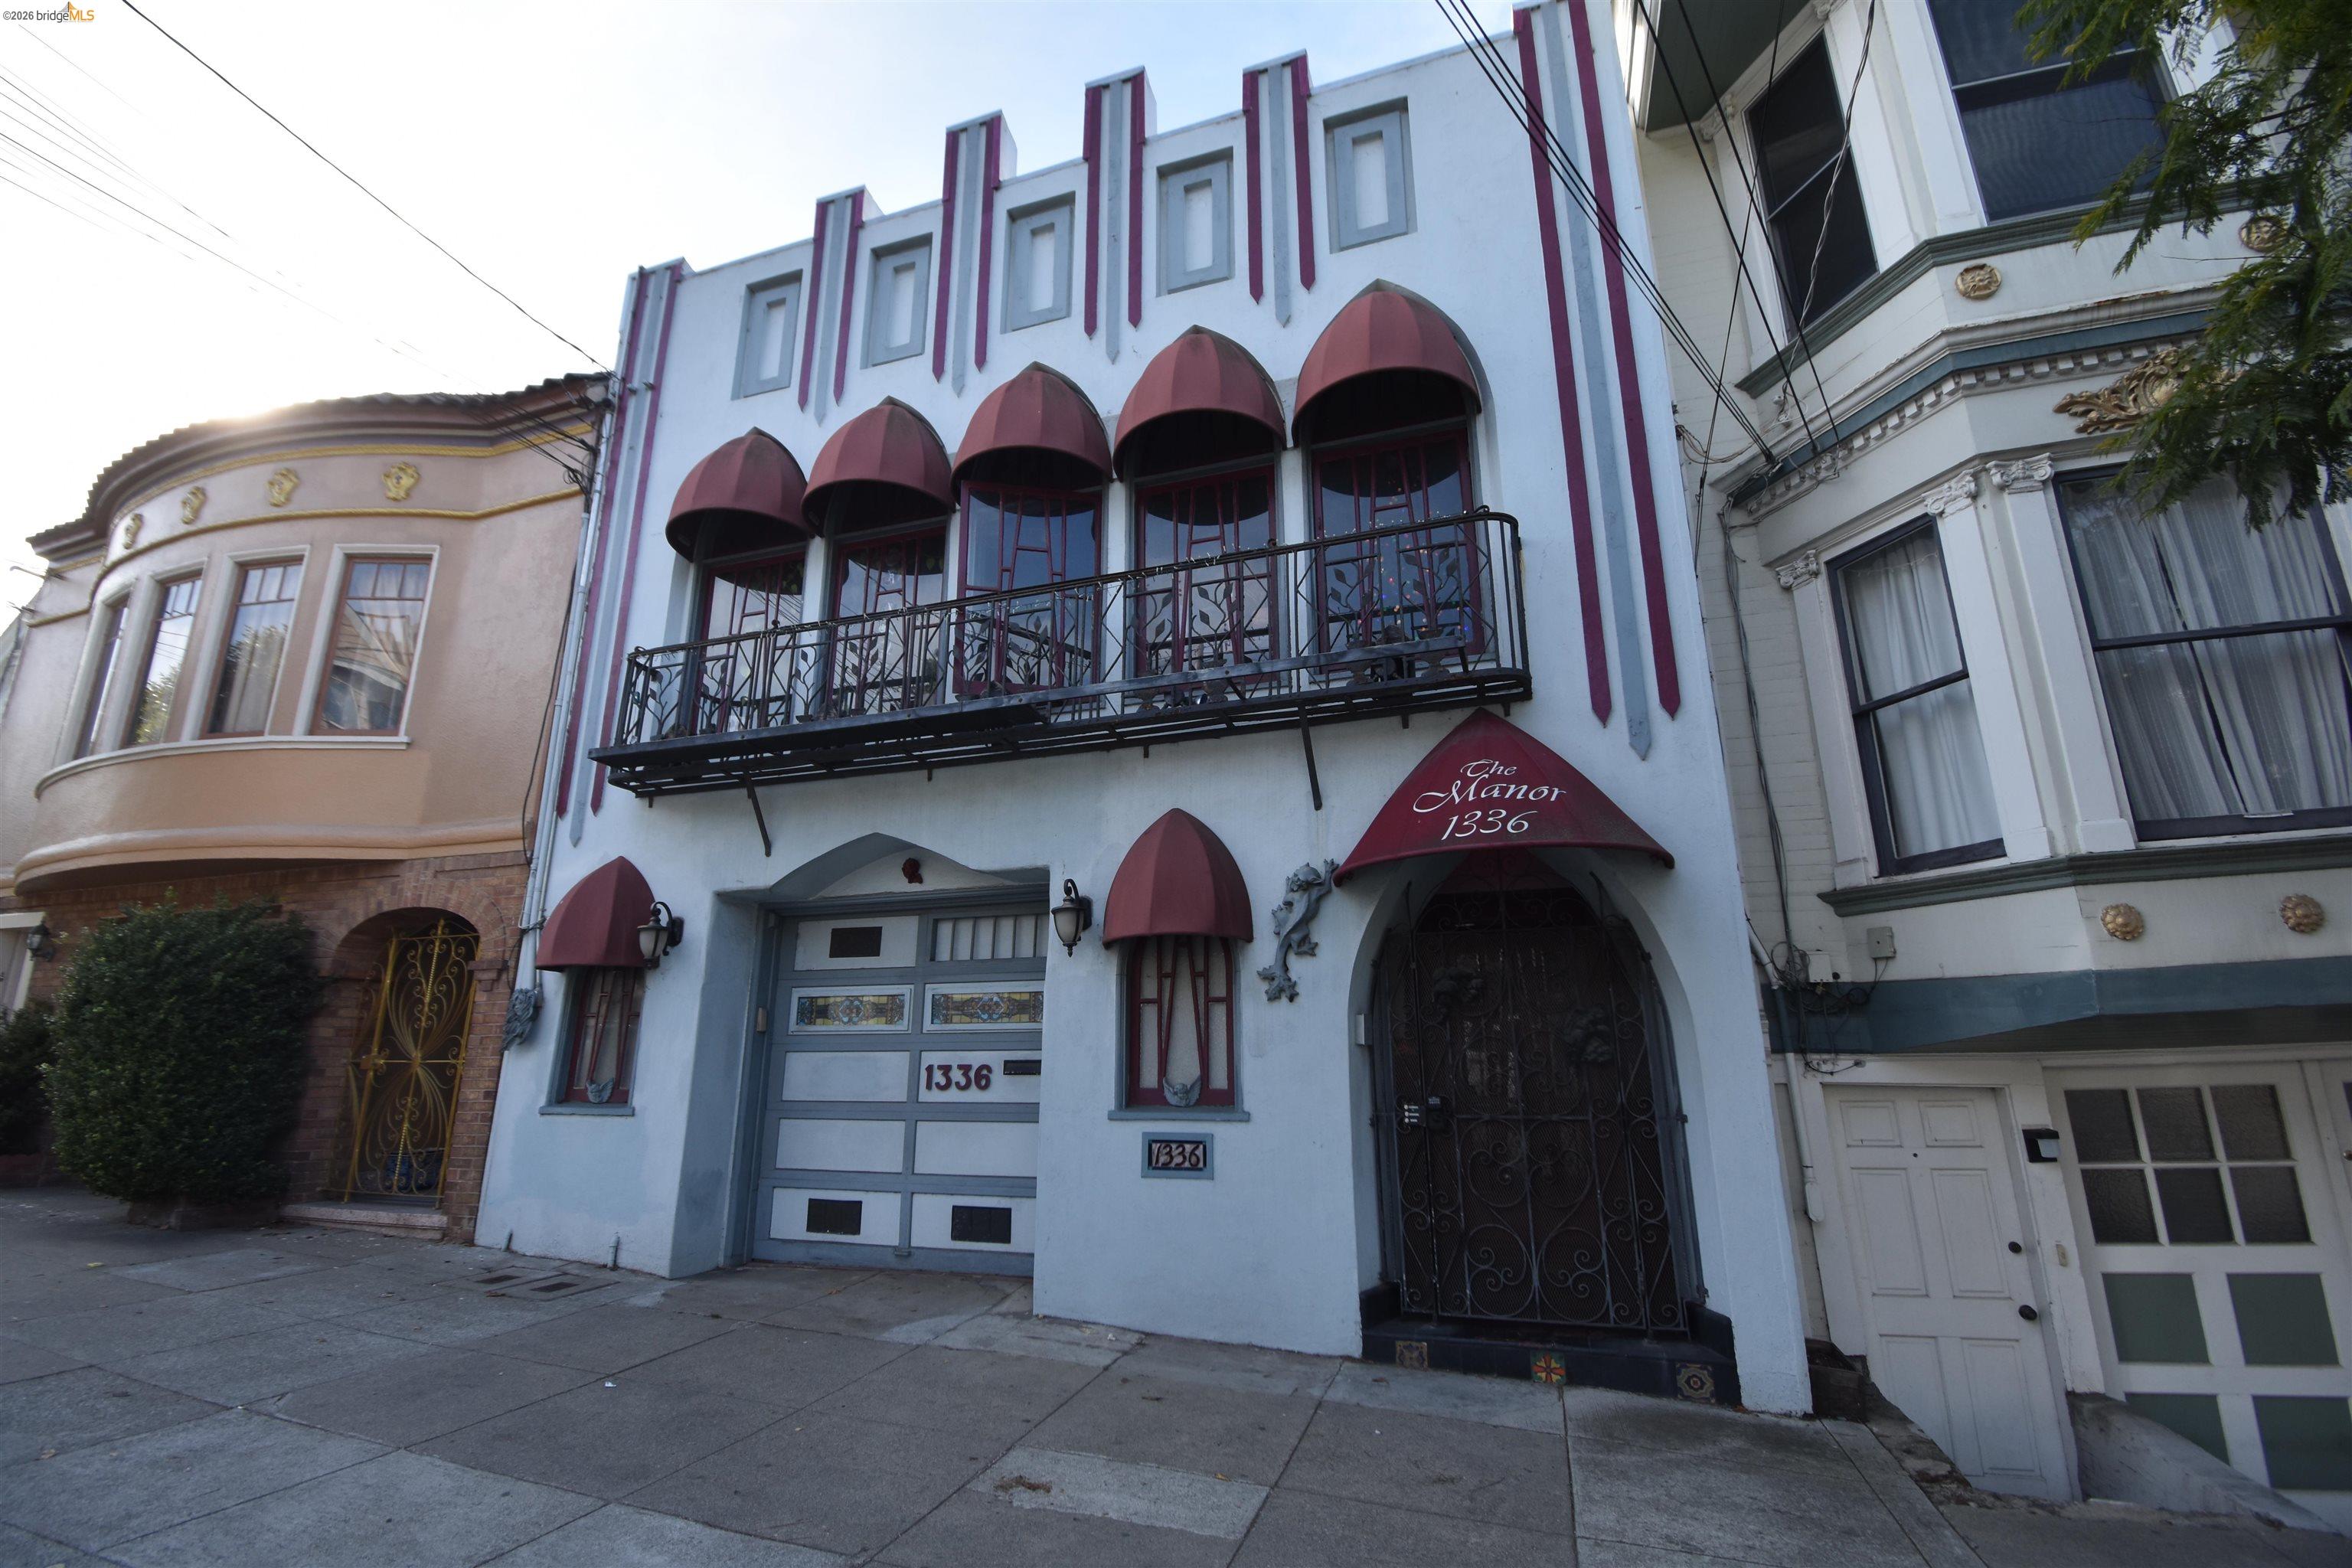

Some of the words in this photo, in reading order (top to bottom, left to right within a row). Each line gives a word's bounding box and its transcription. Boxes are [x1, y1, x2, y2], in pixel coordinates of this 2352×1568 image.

[1460, 759, 1517, 777] The
[1413, 774, 1567, 813] Manor
[1441, 809, 1538, 841] 1336
[925, 1063, 993, 1091] 1336
[1155, 1143, 1200, 1168] 1336
